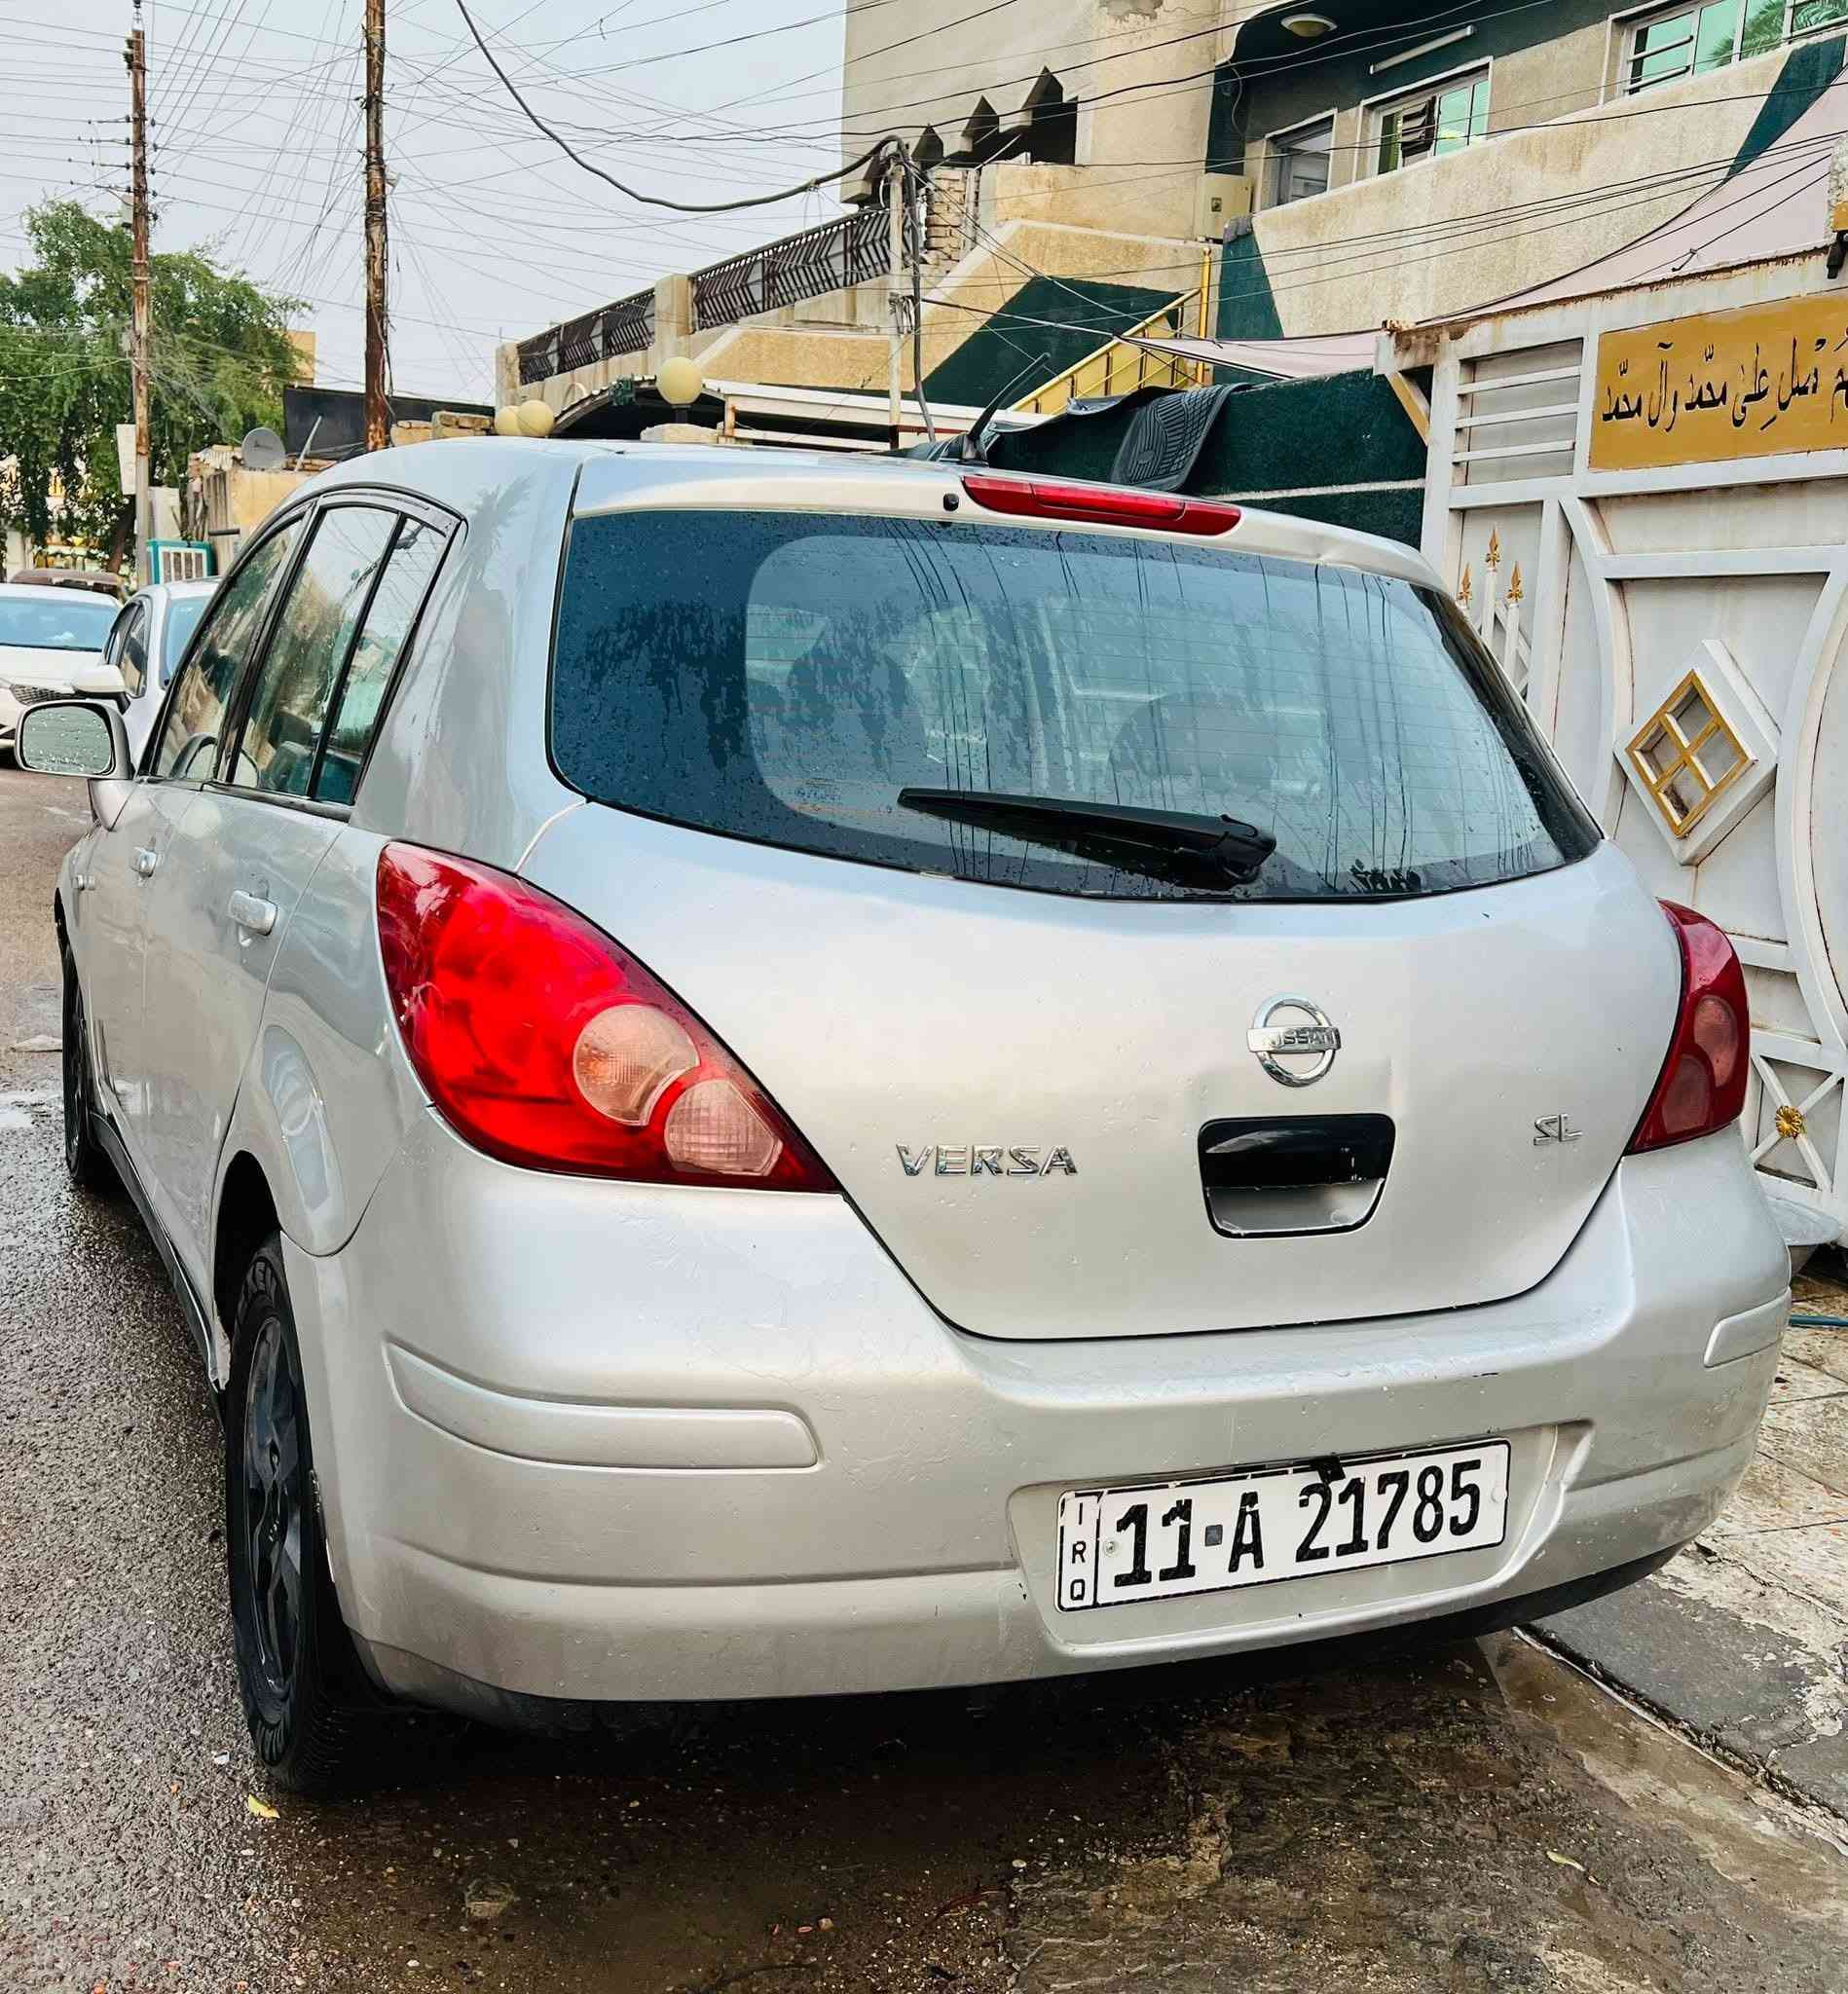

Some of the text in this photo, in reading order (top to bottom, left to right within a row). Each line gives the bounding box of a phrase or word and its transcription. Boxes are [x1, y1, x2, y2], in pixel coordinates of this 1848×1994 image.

[895, 1143, 1079, 1177] VERSA
[1533, 1113, 1583, 1146] SL
[1070, 1502, 1087, 1602] IRQ
[1114, 1459, 1482, 1588] 11 A 21785
